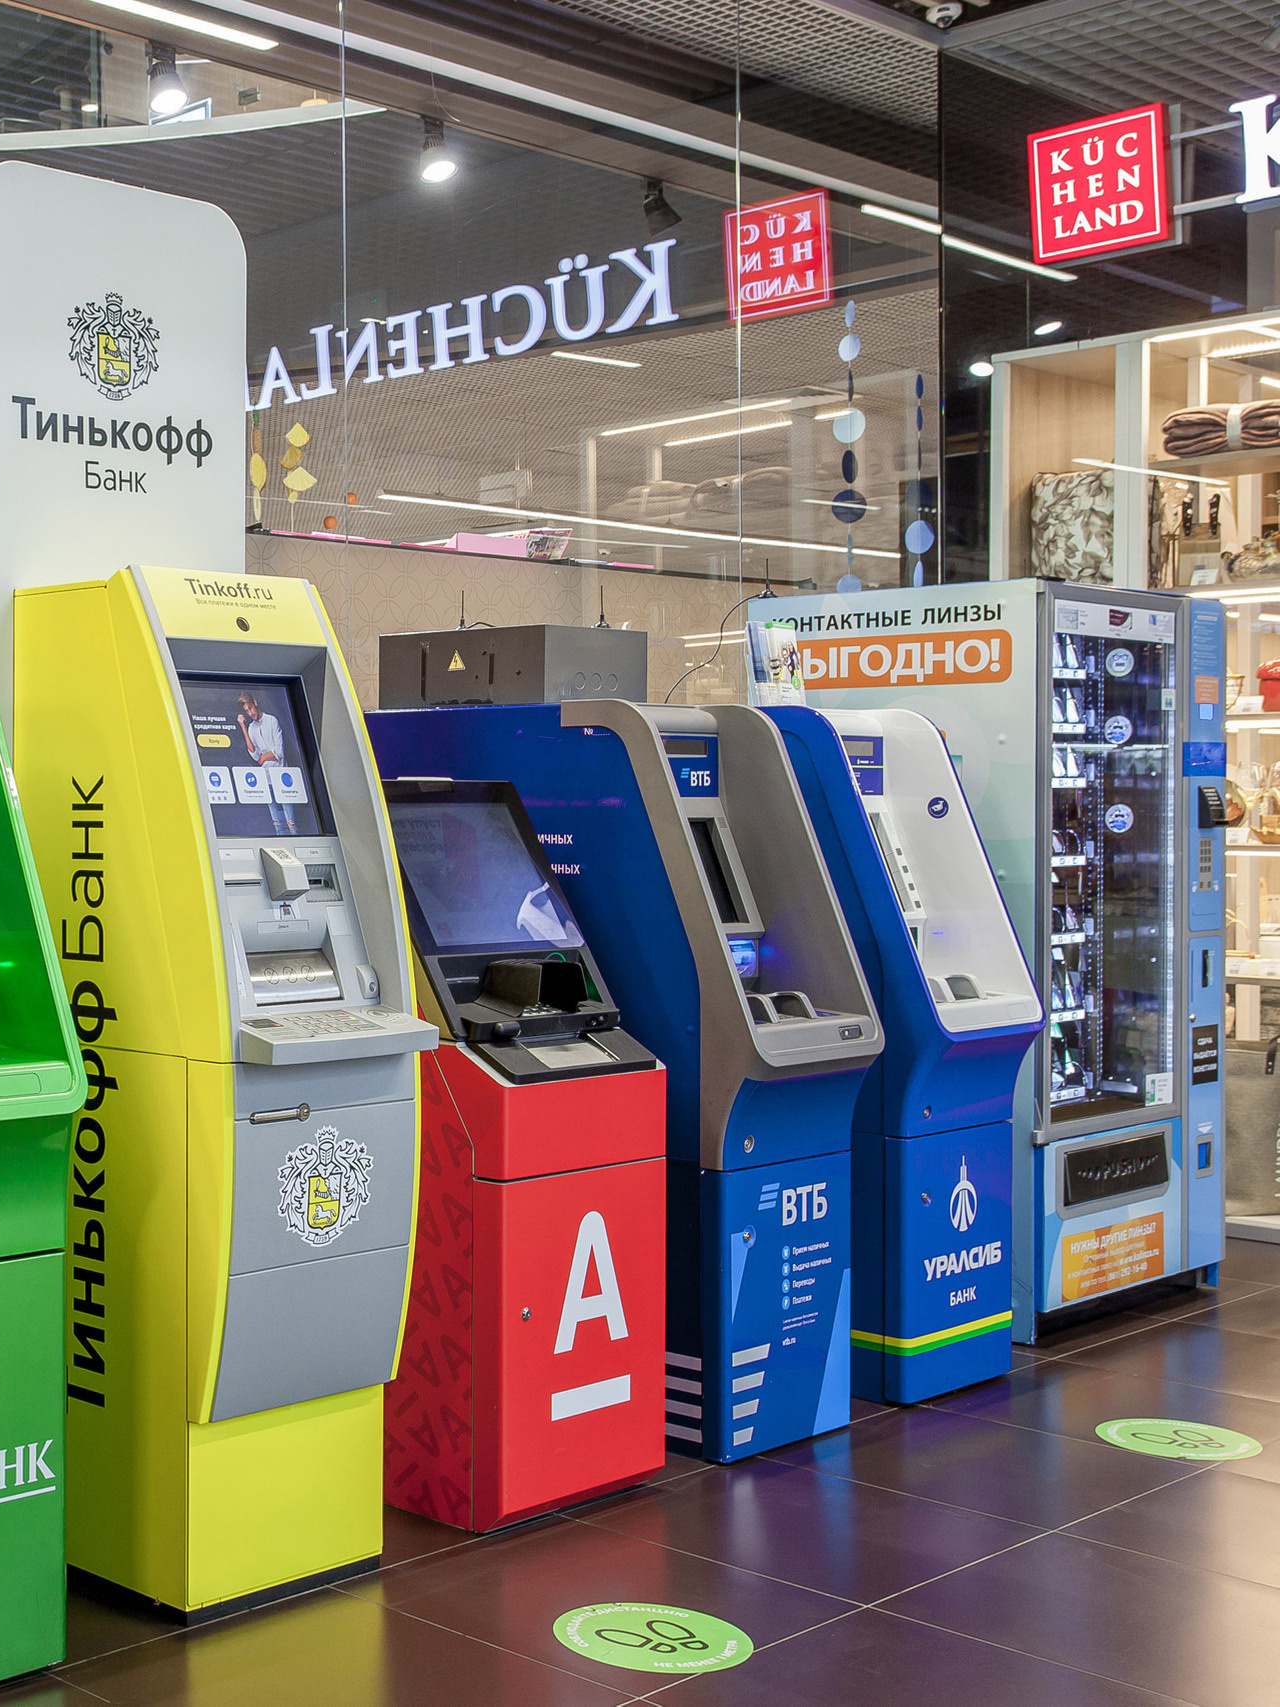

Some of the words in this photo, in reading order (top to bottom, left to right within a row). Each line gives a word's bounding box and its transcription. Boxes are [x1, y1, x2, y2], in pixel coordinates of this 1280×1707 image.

[1050, 132, 1138, 174] KÜC
[1051, 164, 1140, 206] HEN
[1053, 199, 1144, 239] LAND
[12, 395, 213, 468] Тинькофф
[85, 460, 147, 494] Банк
[184, 578, 273, 600] Tinkoff.ru
[921, 603, 1002, 625] ЛИНЗЫ
[799, 638, 1001, 684] ЫГОДНО!
[690, 770, 711, 787] ВТБ
[62, 774, 104, 963] Банк
[782, 1182, 828, 1227] ВТБ
[792, 1245, 808, 1257] Прием
[1070, 1237, 1100, 1254] НУЖНЫ
[1100, 1229, 1127, 1250] ДРУГИЕ
[1128, 1222, 1157, 1239] ЛИНЗЫ?
[792, 1261, 810, 1272] Выдача
[923, 1240, 1002, 1282] УРАЛСИБ
[949, 1285, 977, 1307] БАНК
[594, 1606, 690, 1618] ДИСТАНЦИЮ
[676, 1657, 719, 1668] МЕНЕЕ
